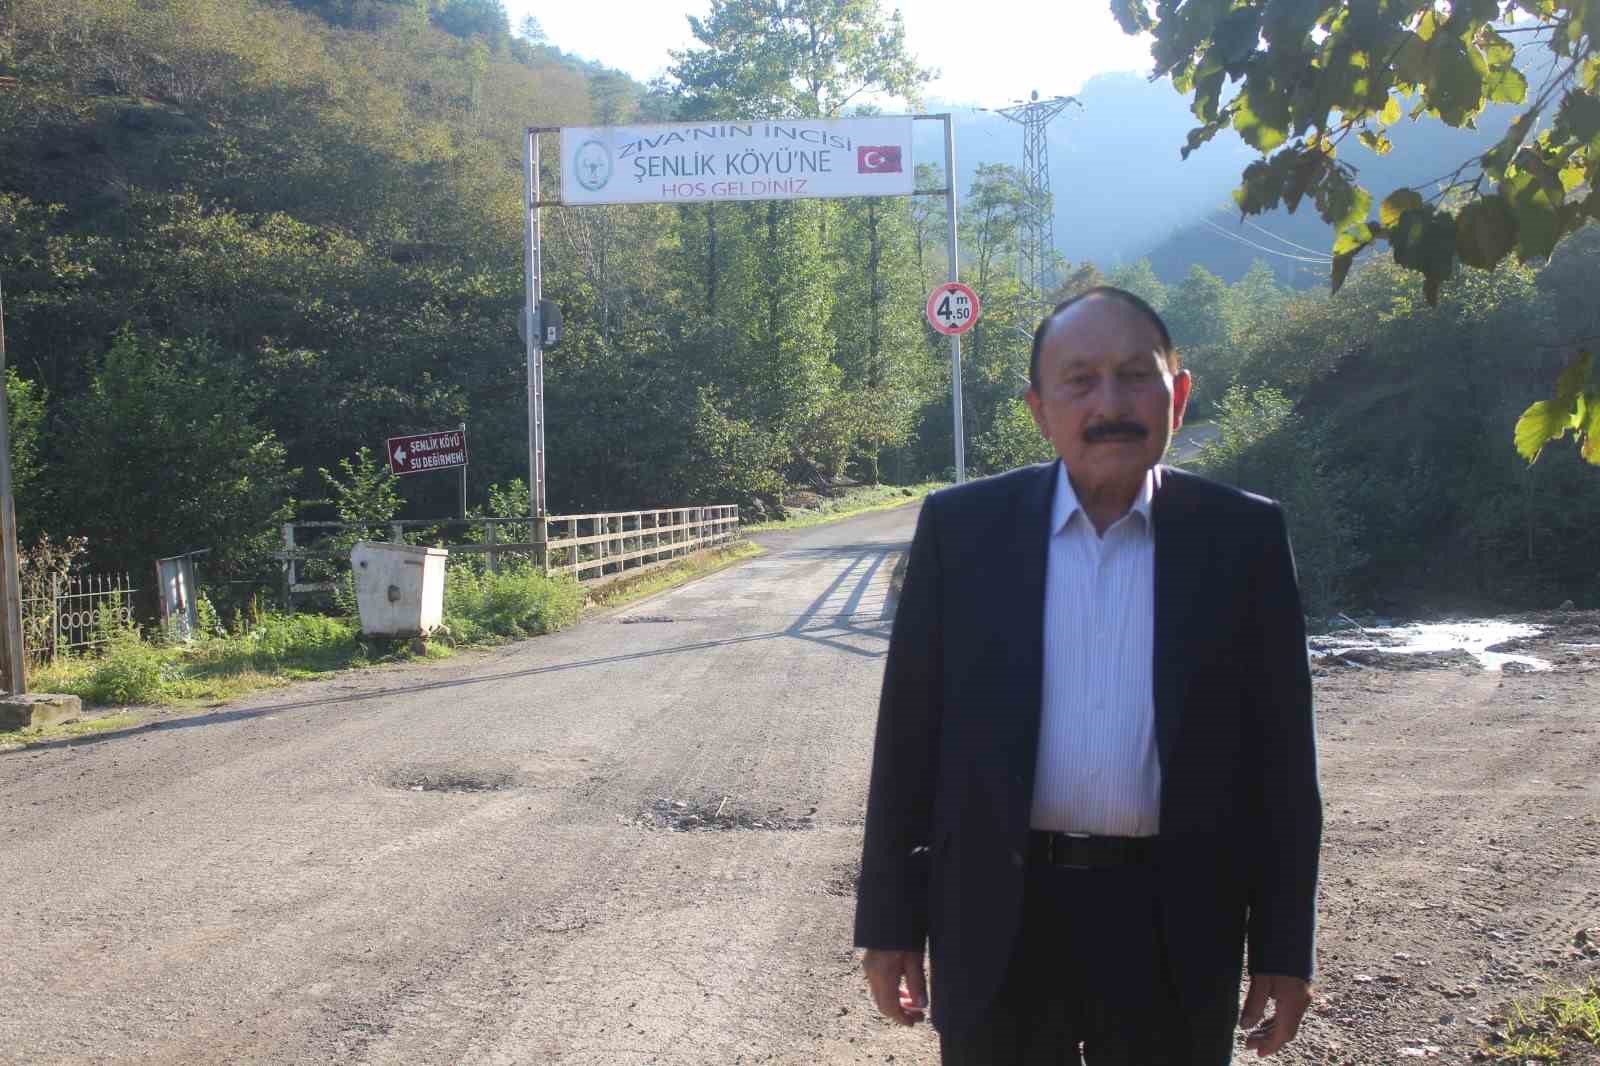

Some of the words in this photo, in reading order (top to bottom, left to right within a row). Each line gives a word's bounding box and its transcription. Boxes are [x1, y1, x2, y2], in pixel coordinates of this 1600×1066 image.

[633, 152, 716, 184] ŞENLİK
[726, 147, 832, 176] KÖYÜ'NE
[410, 437, 439, 454] ŞENLİK
[439, 432, 460, 449] KÖYÜ
[410, 457, 421, 470] SU
[422, 449, 464, 468] DEĞİRMENİ
